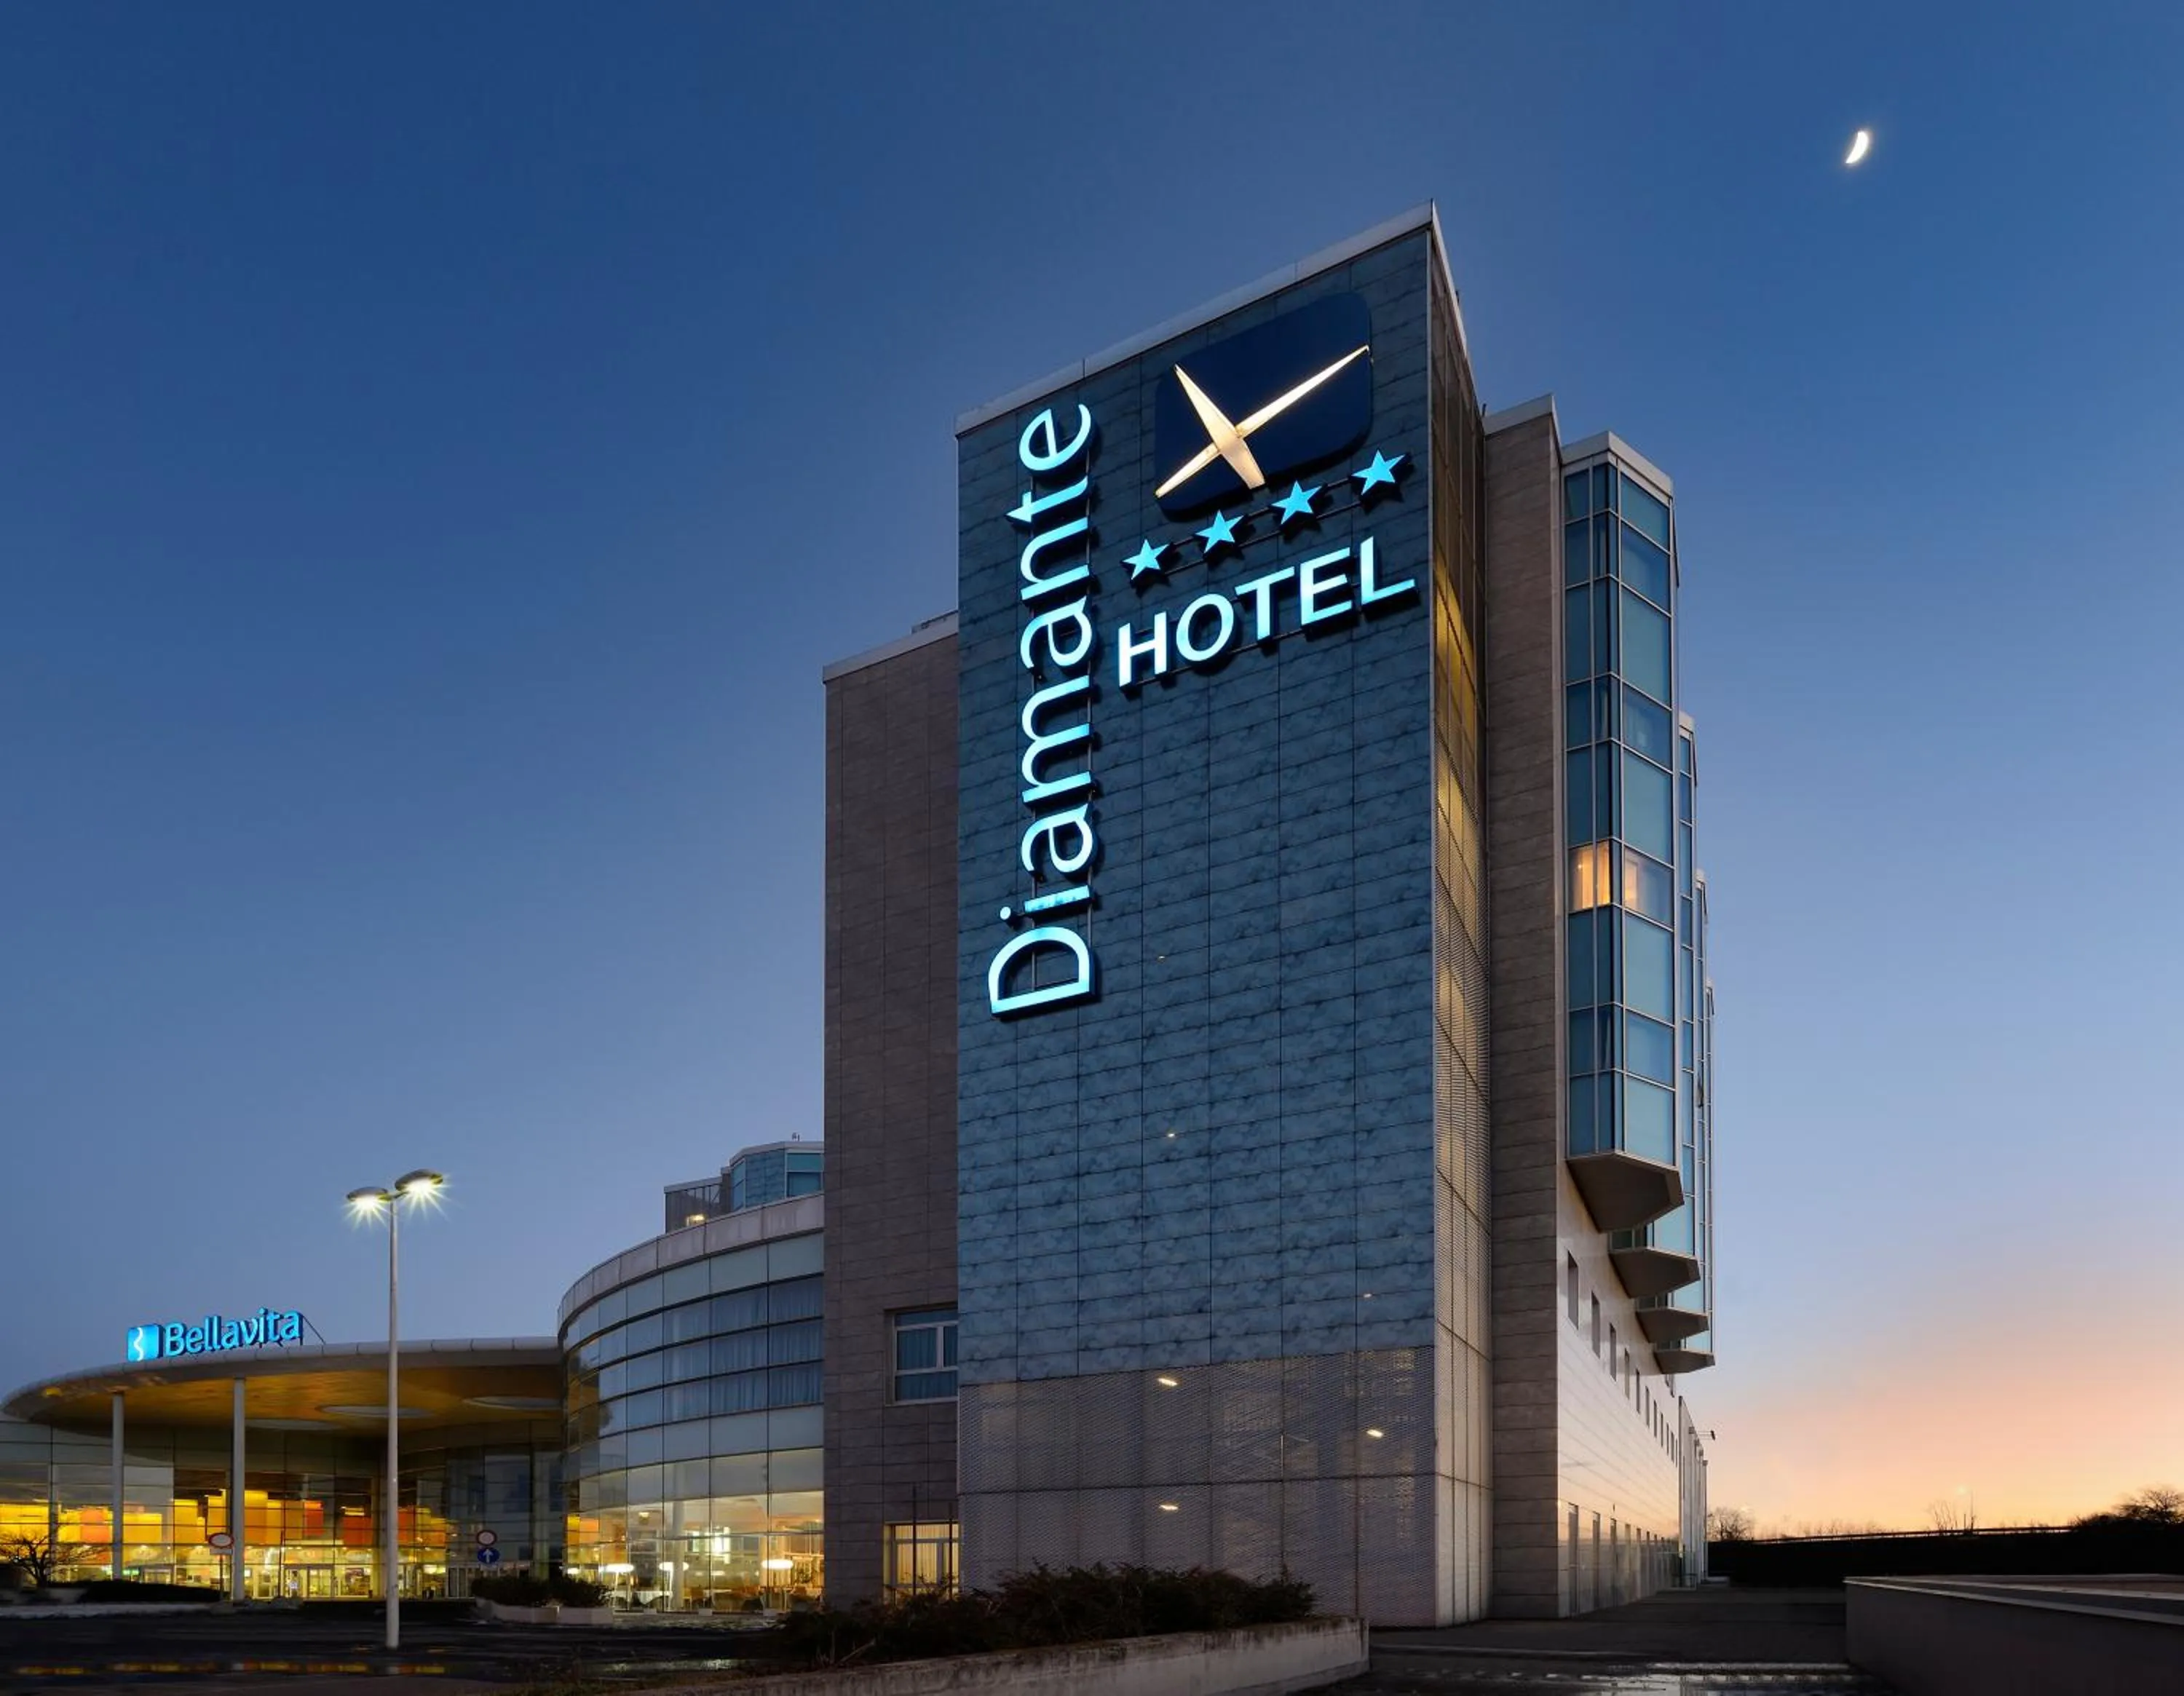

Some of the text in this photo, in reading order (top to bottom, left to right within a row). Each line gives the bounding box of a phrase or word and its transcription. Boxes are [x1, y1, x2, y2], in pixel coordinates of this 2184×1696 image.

[1117, 536, 1415, 688] HOTEL
[988, 403, 1093, 1014] Diamante
[164, 1307, 301, 1357] Bellavita
